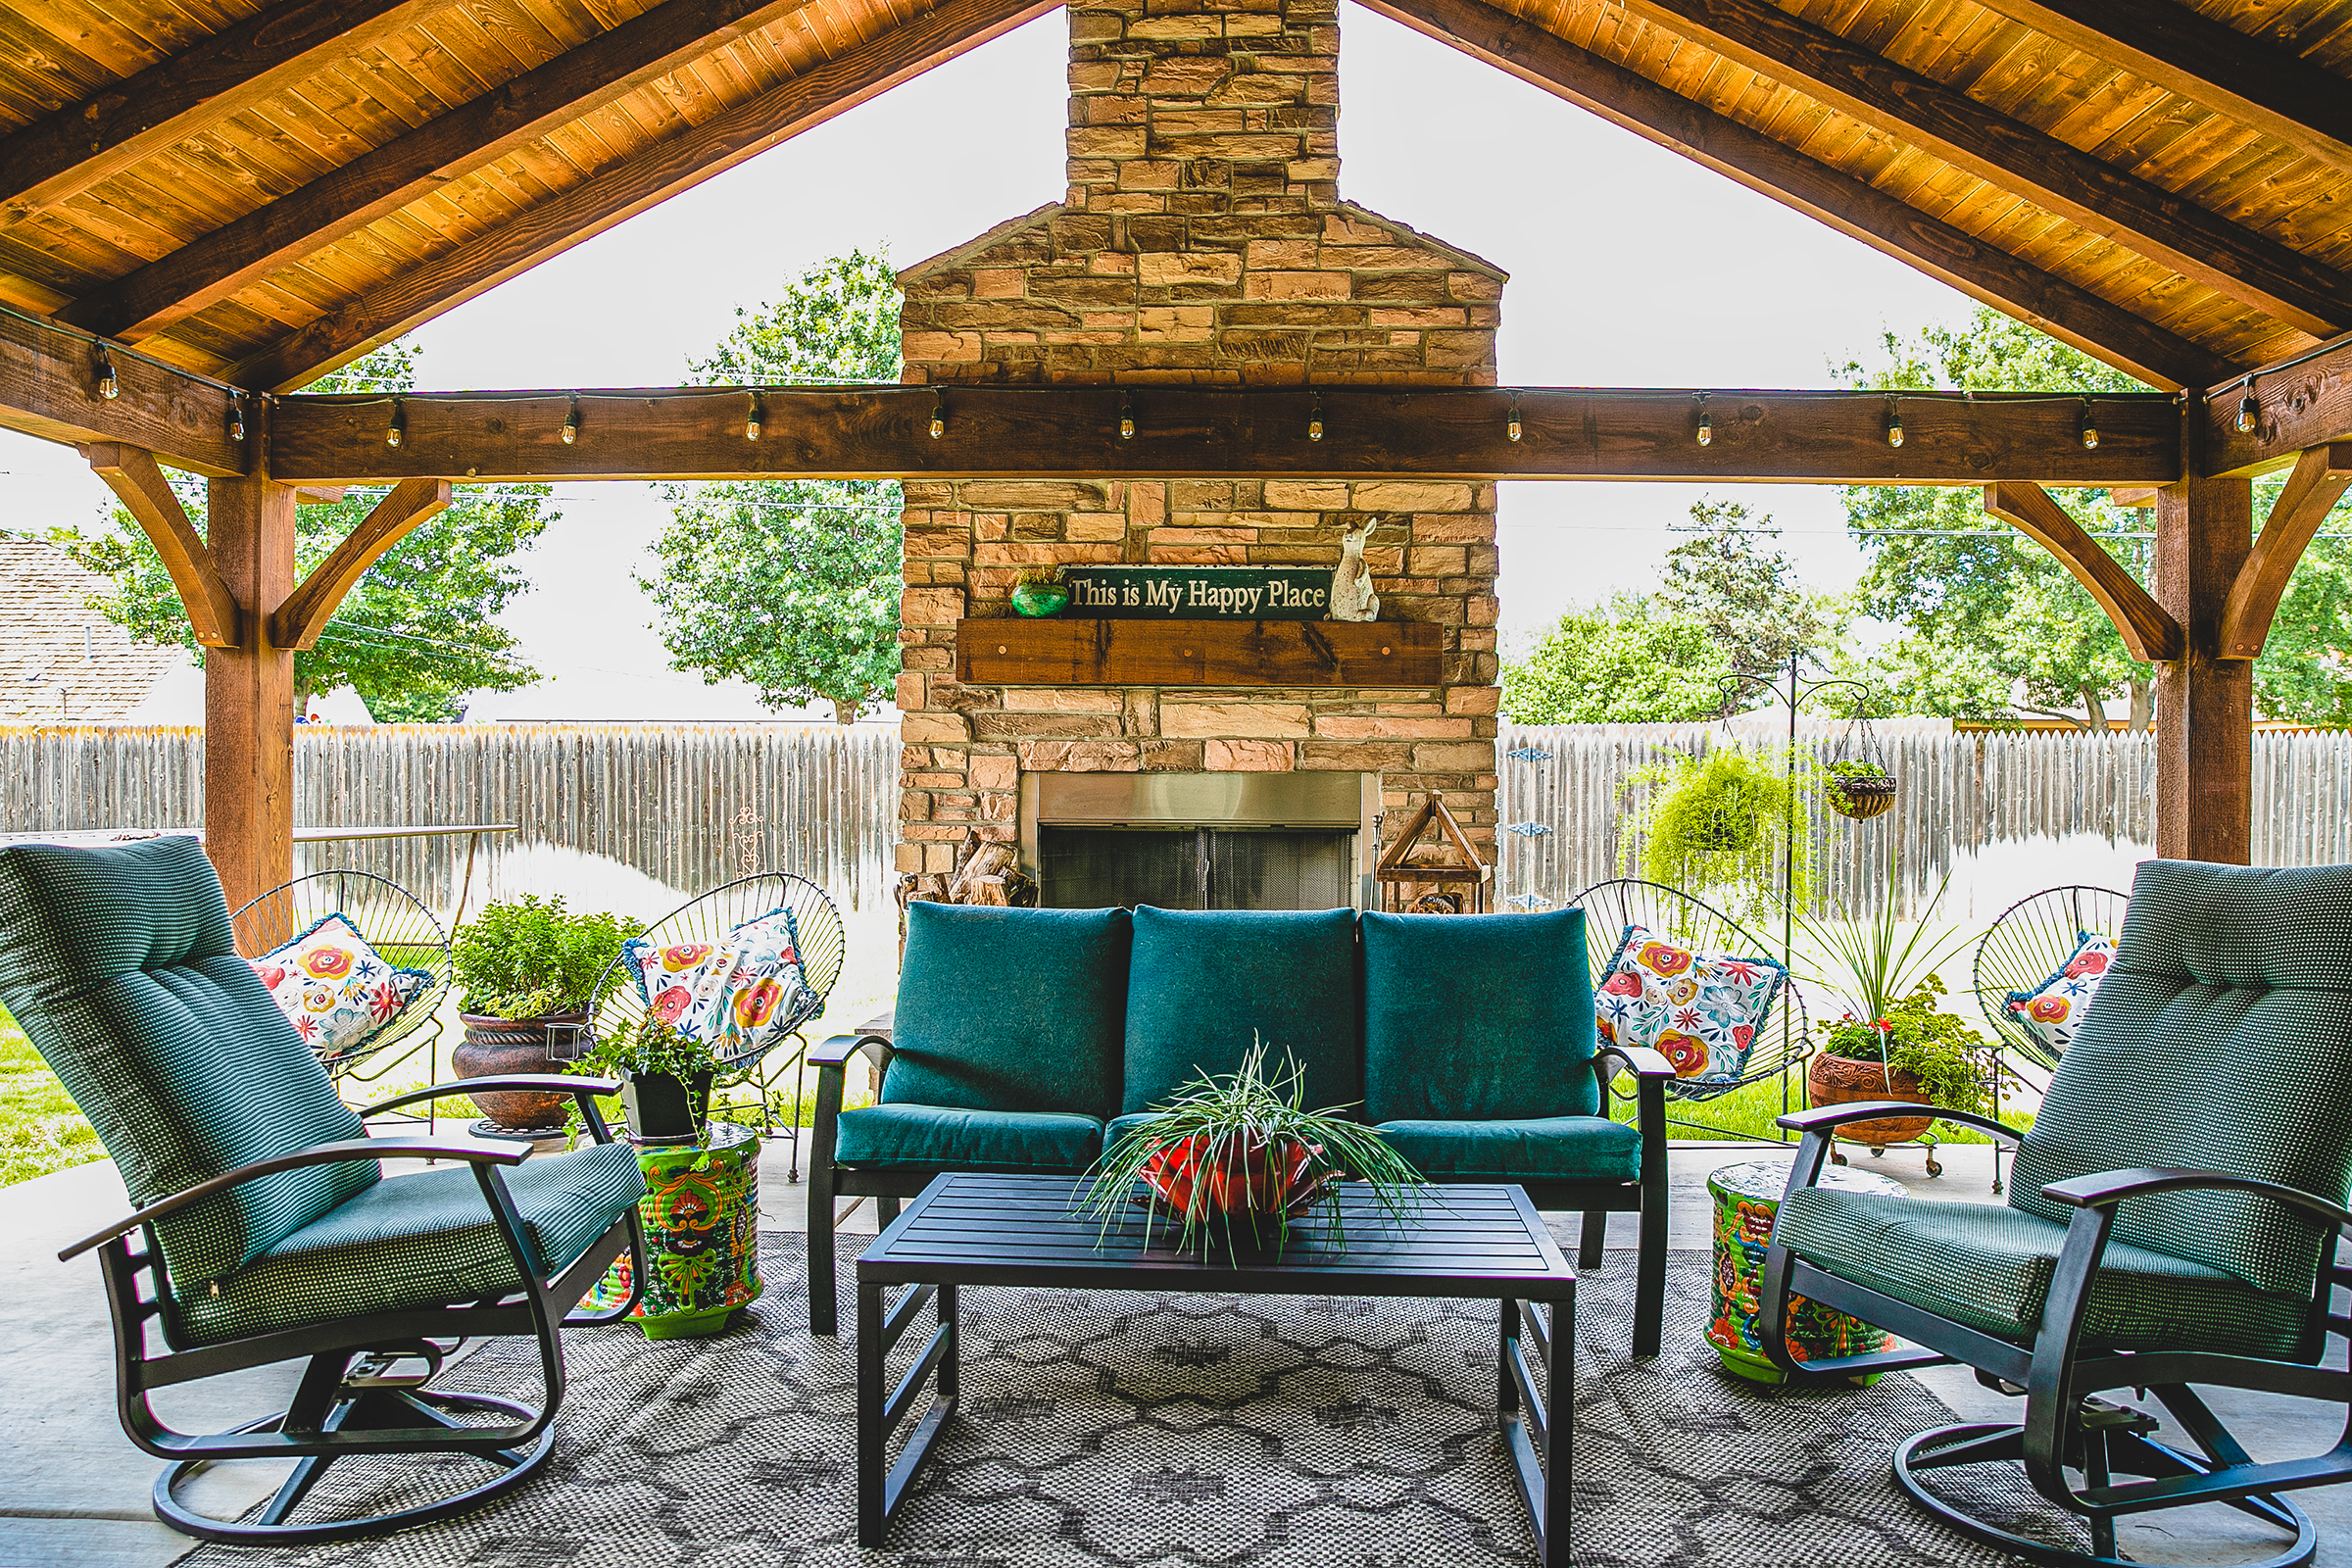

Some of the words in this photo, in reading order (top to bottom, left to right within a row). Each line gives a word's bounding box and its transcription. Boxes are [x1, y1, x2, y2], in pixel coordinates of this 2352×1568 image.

[1072, 578, 1117, 606] This
[1122, 579, 1140, 606] is
[1145, 579, 1183, 613] My
[1188, 579, 1263, 613] Happy
[1267, 579, 1326, 608] Place
